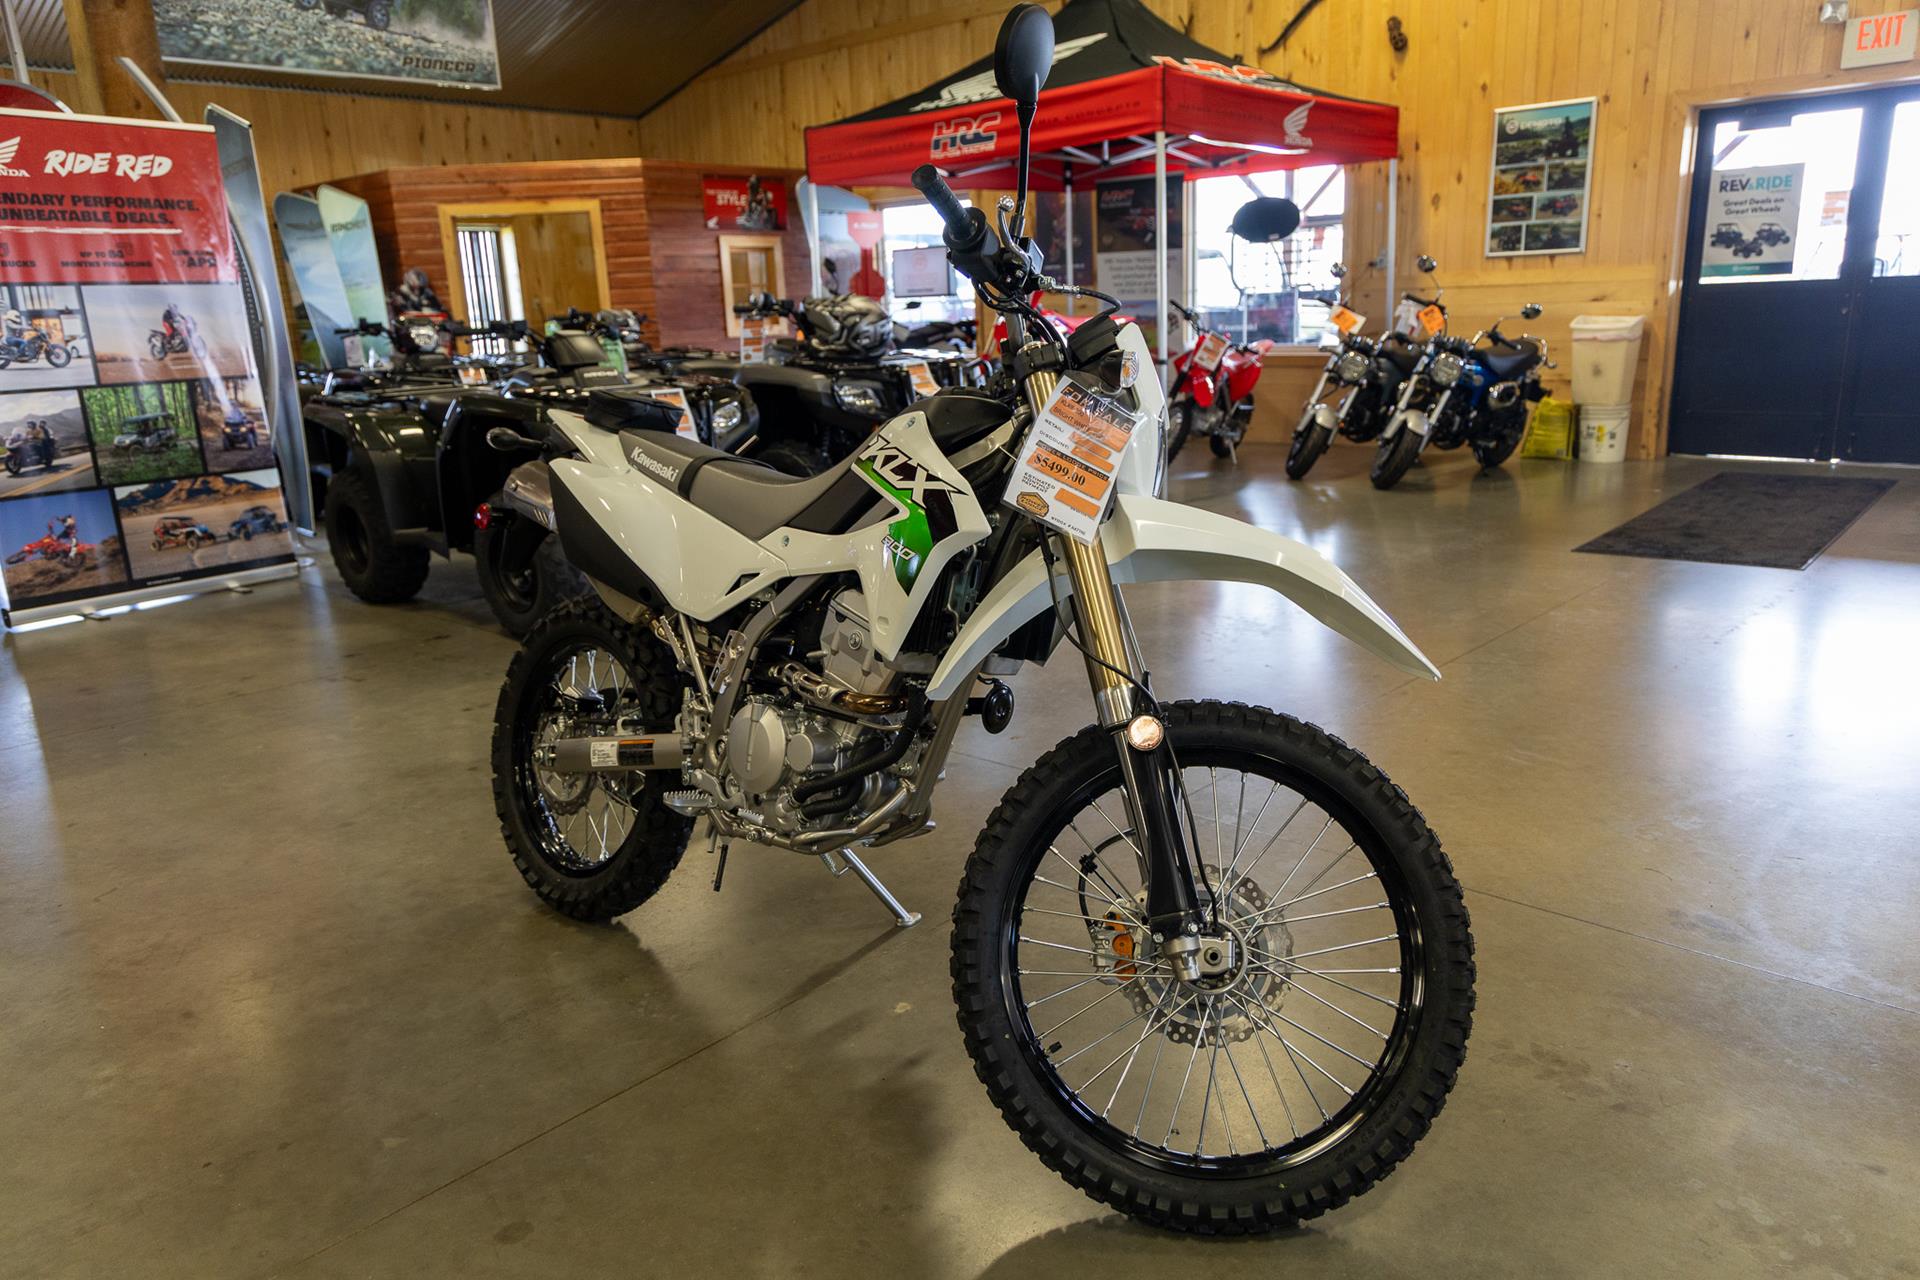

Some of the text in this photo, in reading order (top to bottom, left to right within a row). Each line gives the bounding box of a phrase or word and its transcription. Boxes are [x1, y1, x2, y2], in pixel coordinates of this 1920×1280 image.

[1856, 14, 1907, 51] EXIT
[402, 56, 476, 73] PIONEER
[931, 112, 1001, 151] HRC
[43, 149, 173, 183] RIDE RED
[71, 193, 199, 212] PERFORMANCE.
[116, 210, 174, 225] DEALS.
[630, 446, 680, 483] Kawasaki
[859, 433, 969, 510] KLX
[1034, 452, 1087, 487] $5499.00
